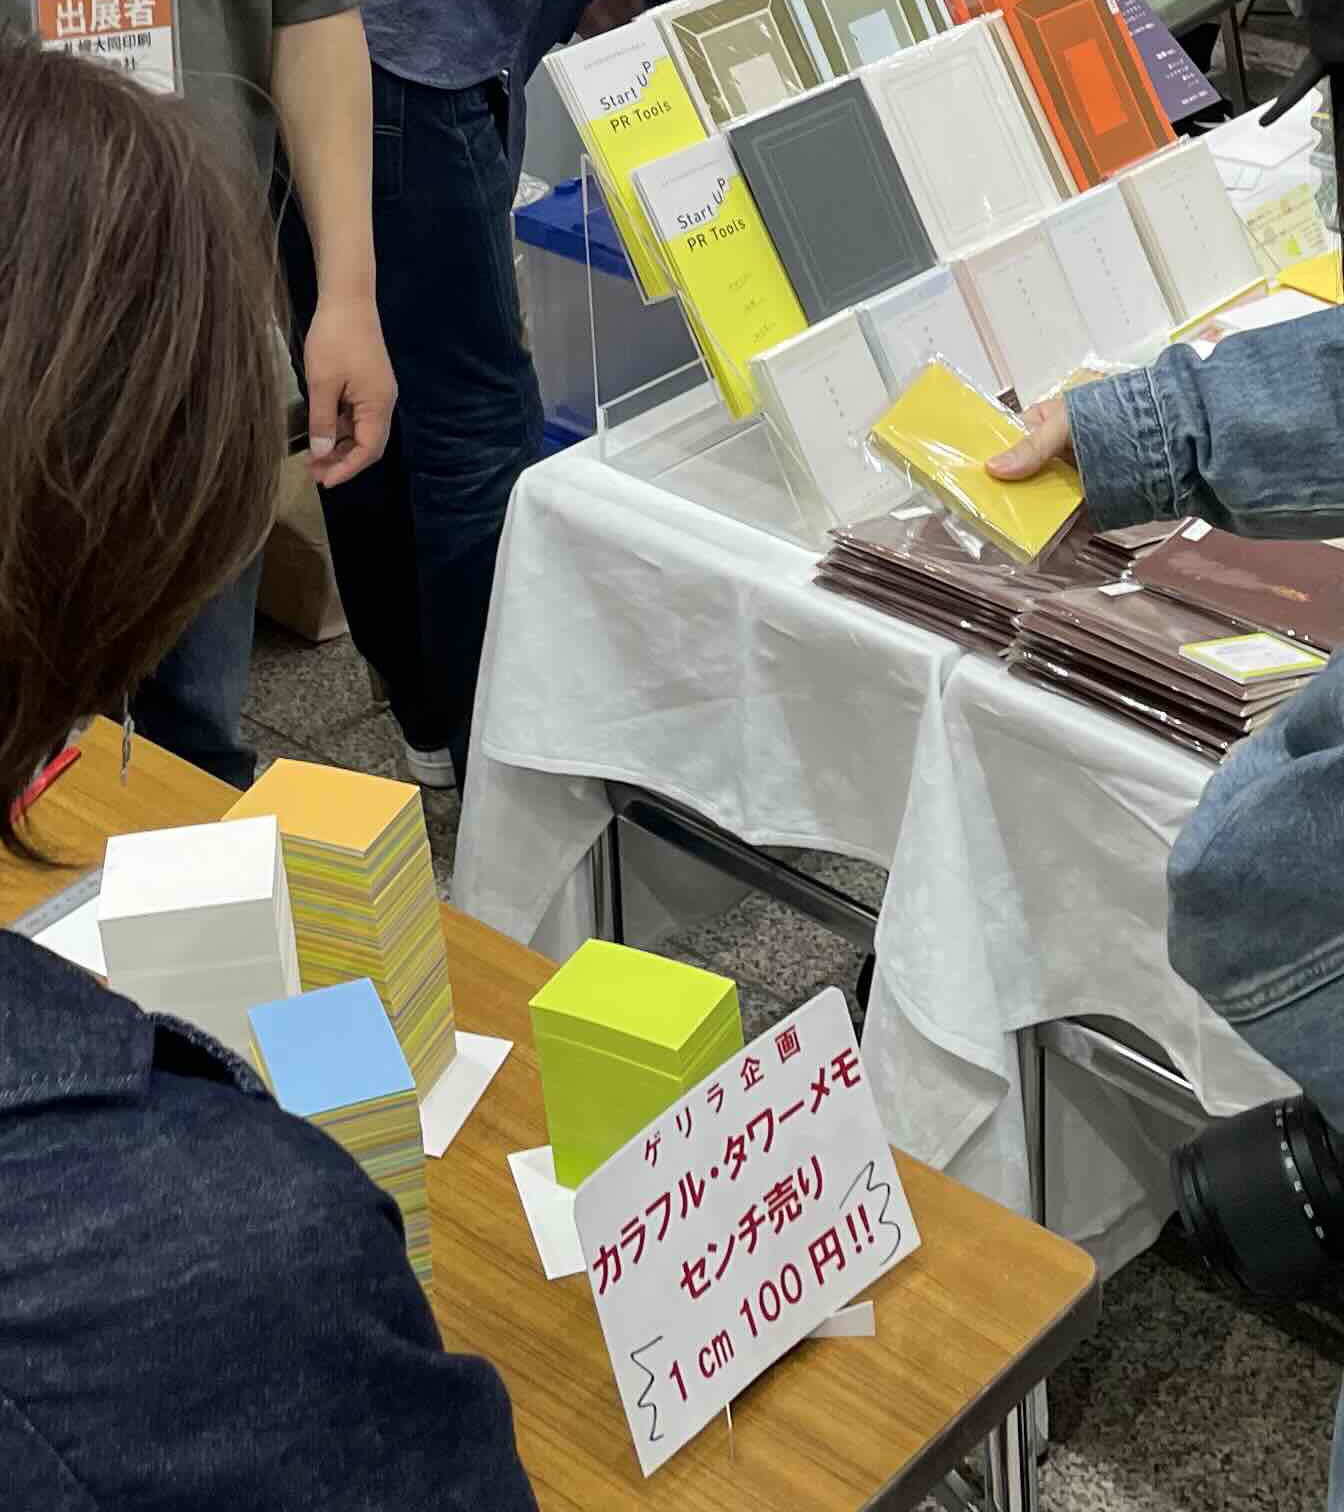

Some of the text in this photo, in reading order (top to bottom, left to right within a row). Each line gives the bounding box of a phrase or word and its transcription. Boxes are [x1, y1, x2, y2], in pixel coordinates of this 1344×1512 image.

[599, 88, 639, 112] Start
[609, 99, 673, 135] PR Tools
[676, 205, 715, 231] Start
[687, 216, 747, 253] PR Tools
[643, 1024, 801, 1168] ゲリラ企画
[592, 1047, 862, 1296] カラフル・タワーメモ
[679, 1155, 826, 1300] センチ売り
